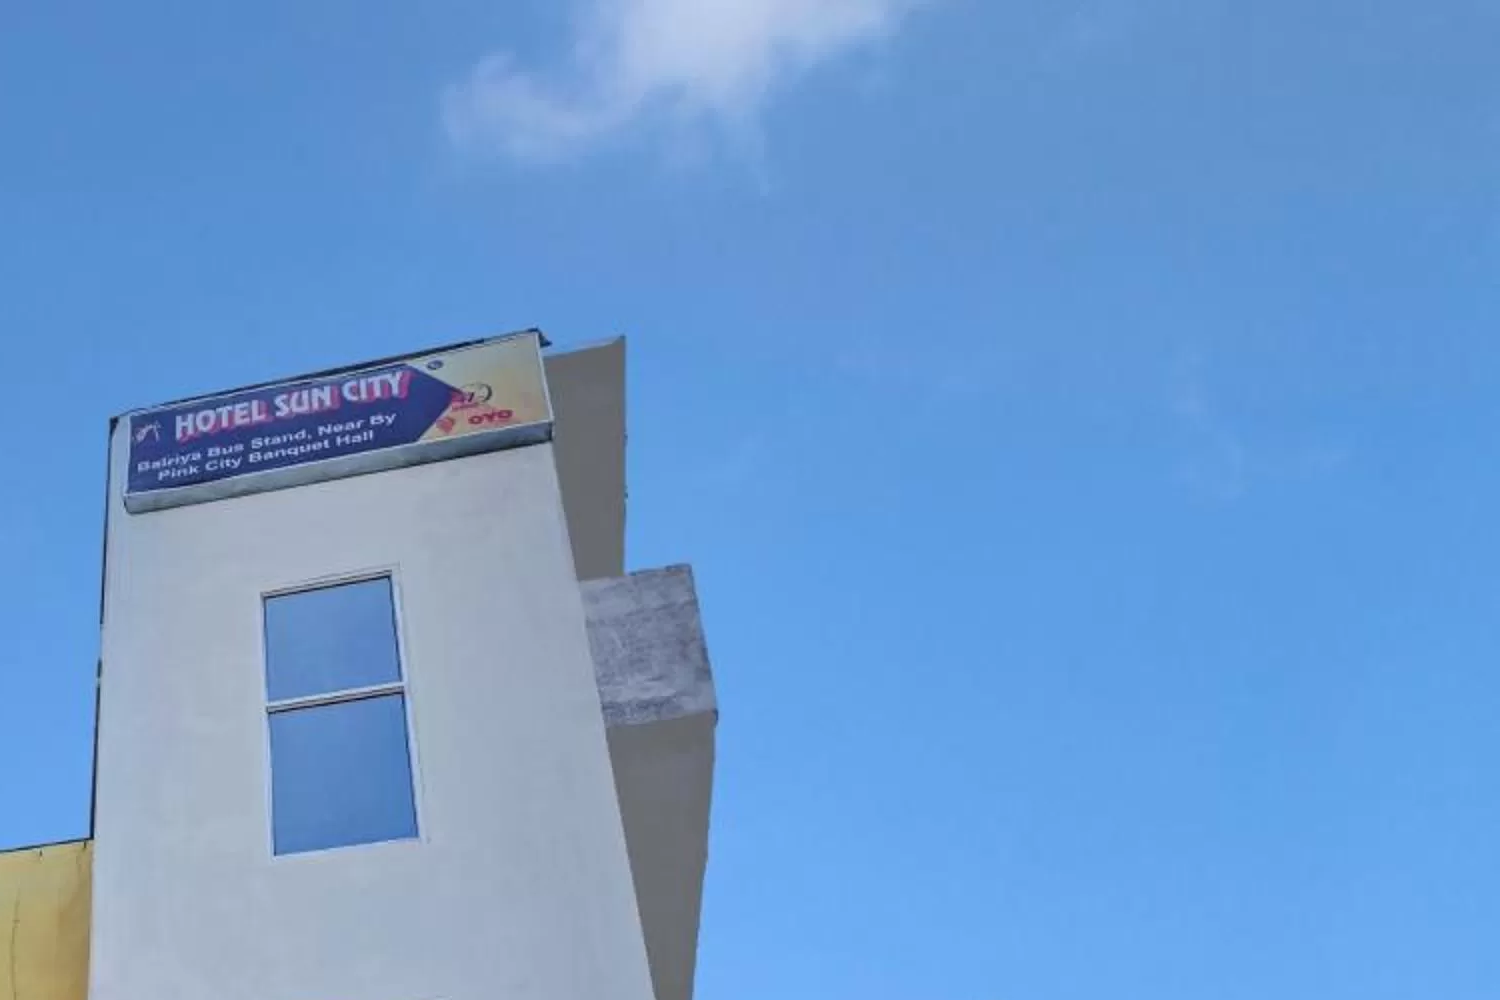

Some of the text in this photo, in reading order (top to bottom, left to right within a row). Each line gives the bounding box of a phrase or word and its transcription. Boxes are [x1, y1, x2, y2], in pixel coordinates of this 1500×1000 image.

[175, 370, 412, 442] HOTEL SUN CITY
[467, 409, 514, 425] OYO
[137, 413, 397, 473] Bairiya Bus Stand, Near By
[158, 430, 374, 480] Pink City Banquet Hall
